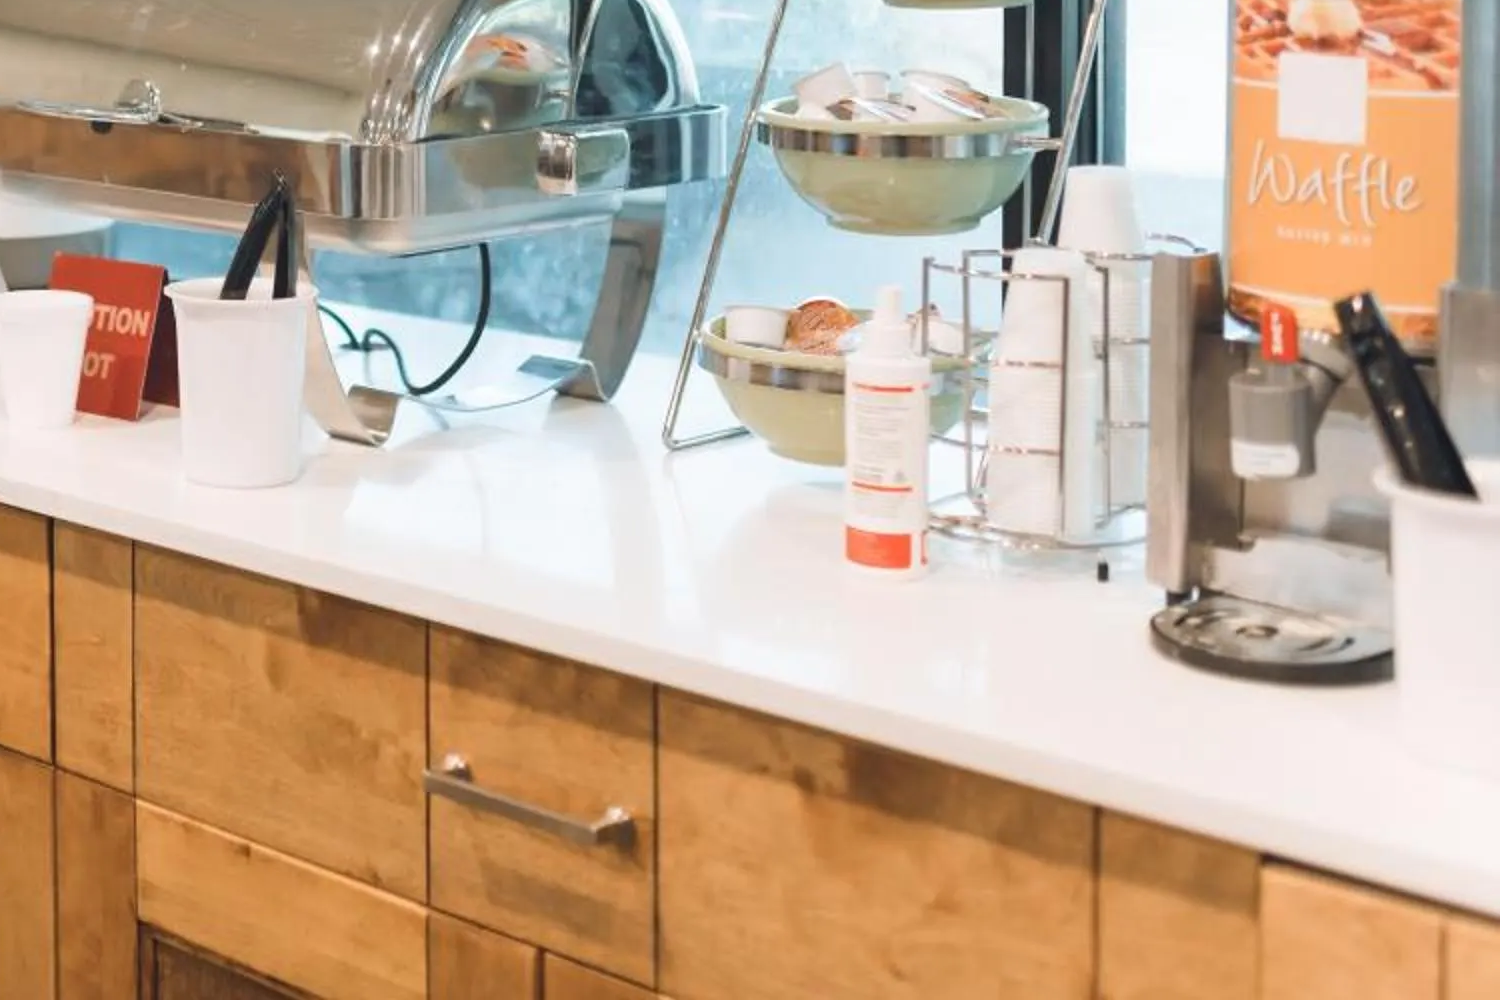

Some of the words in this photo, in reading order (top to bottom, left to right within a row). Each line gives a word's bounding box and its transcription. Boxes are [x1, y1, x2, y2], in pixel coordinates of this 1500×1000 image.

[1248, 138, 1423, 228] Waffle
[93, 303, 151, 338] TION
[83, 352, 116, 380] OT
